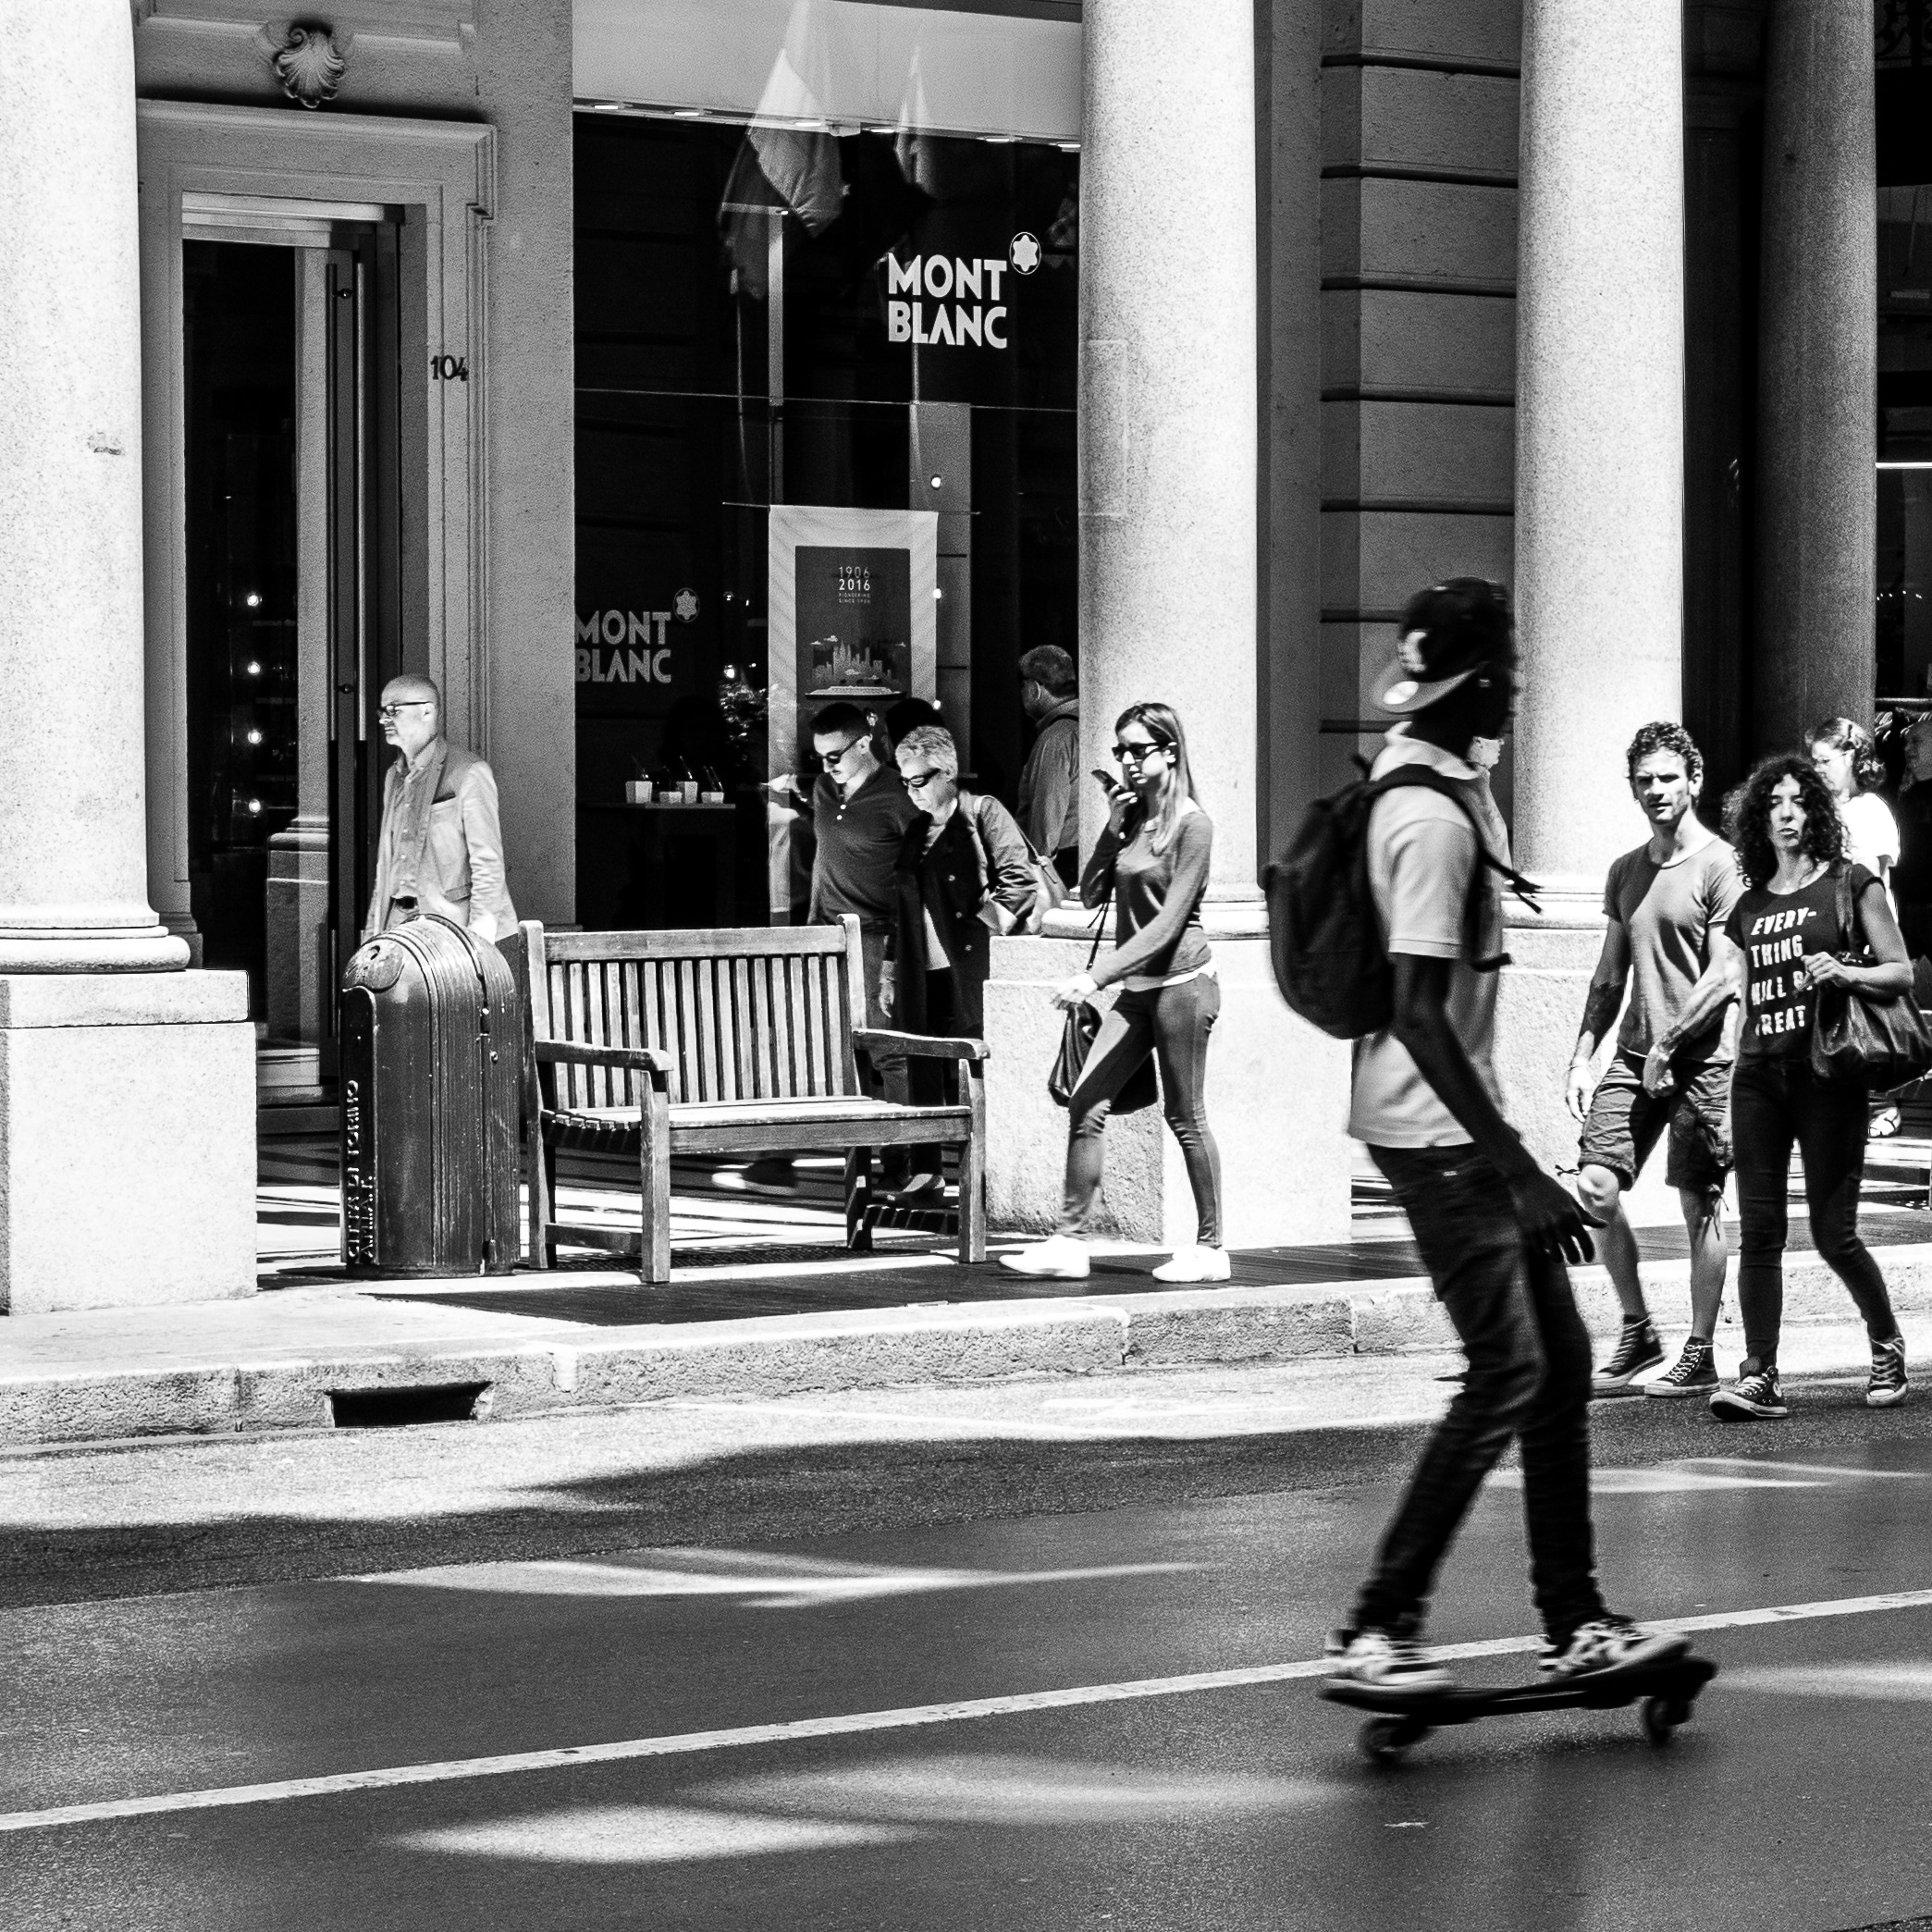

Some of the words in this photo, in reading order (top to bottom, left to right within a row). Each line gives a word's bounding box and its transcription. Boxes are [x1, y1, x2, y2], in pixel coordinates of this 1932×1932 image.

[889, 252, 1007, 301] MONT
[889, 301, 1007, 349] BLANC
[430, 355, 469, 382] 104
[839, 566, 870, 579] 1906
[839, 578, 871, 591] 2016
[574, 609, 671, 645] MONT
[574, 648, 671, 683] BLANC
[1751, 907, 1817, 936] EVERY-
[1750, 935, 1803, 967] THING
[1792, 971, 1814, 993] B
[347, 1079, 360, 1161] TORINO
[347, 1167, 360, 1188] DI
